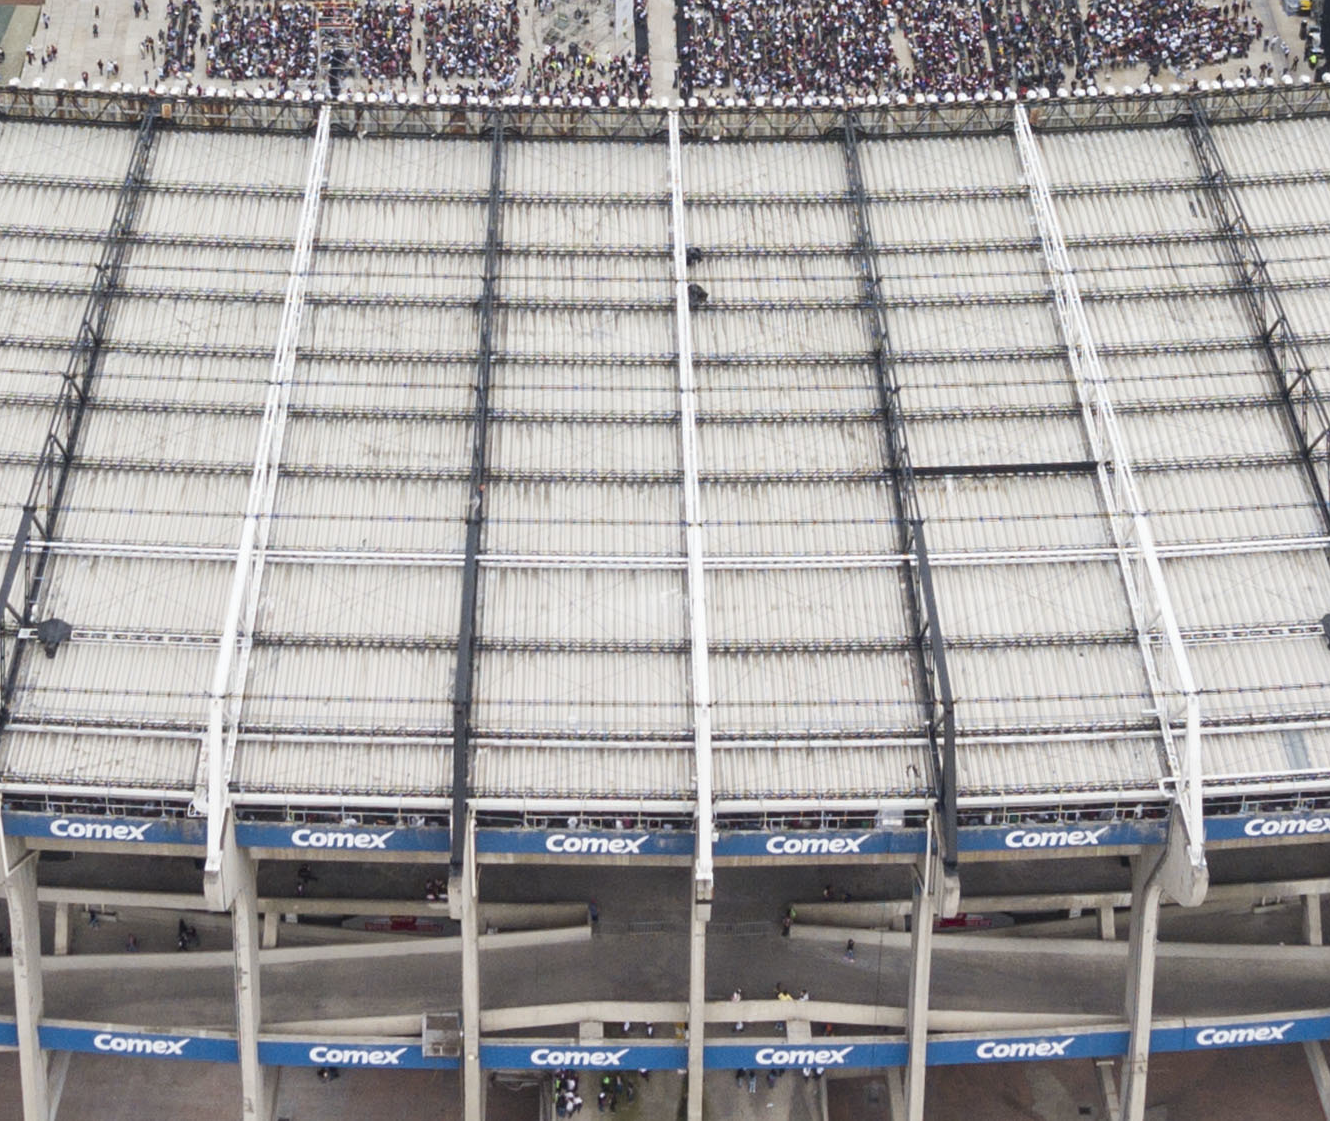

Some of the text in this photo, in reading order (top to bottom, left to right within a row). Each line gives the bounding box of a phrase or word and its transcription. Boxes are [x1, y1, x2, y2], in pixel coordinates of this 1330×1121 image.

[50, 818, 152, 841] Comex
[291, 828, 394, 849] Comex
[1005, 826, 1109, 849] Comex
[545, 834, 649, 854] Comex
[766, 834, 869, 854] Comex
[93, 1033, 190, 1056] Comex
[1196, 1022, 1295, 1046] Comex
[309, 1046, 407, 1064] Comex
[530, 1048, 630, 1067] Comex
[755, 1046, 853, 1065] Comex
[976, 1038, 1075, 1060] Comex
